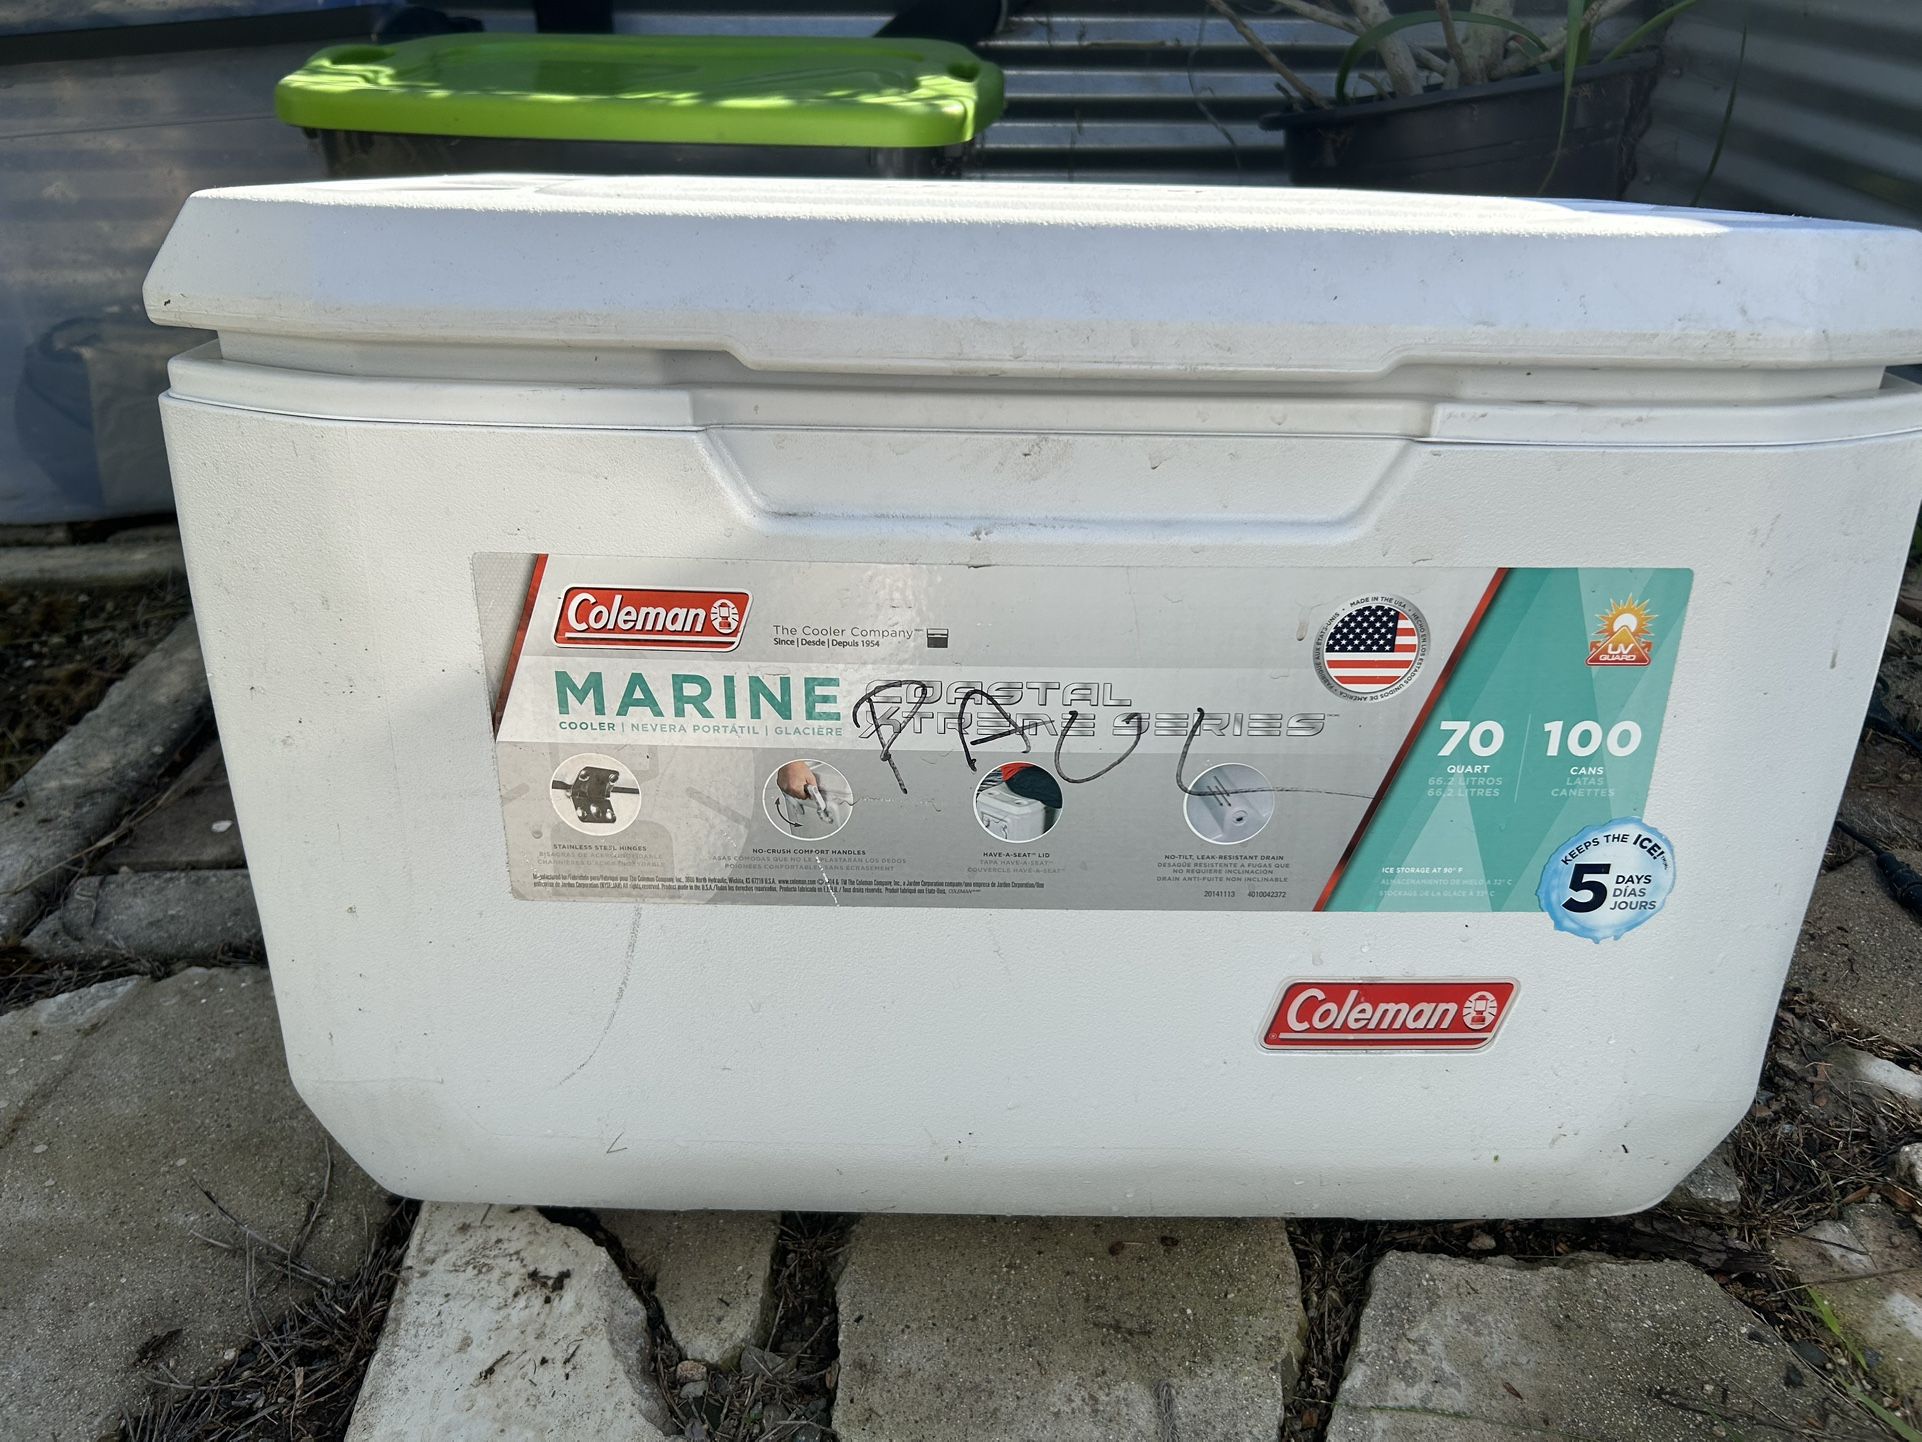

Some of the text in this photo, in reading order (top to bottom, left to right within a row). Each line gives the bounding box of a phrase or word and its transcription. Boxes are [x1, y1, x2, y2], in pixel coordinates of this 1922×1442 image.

[1350, 596, 1370, 608] MADE
[1380, 596, 1393, 604] THE
[1394, 600, 1407, 609] USA
[567, 592, 708, 632] Coleman
[1412, 612, 1426, 632] HECHO
[773, 625, 797, 636] The
[802, 625, 846, 637] Cooler
[774, 638, 880, 648] Since Desde Depuis 1954
[1421, 632, 1427, 644] EN
[1608, 643, 1635, 655] UV
[1404, 657, 1424, 685] ESTADOS
[554, 670, 842, 722] MARINE
[865, 679, 1132, 707] COASTAL
[858, 706, 1326, 738] XTREME SERIES
[558, 721, 843, 737] COOLER NEVERA PORTÁTIL GLACIÈRE
[852, 679, 1262, 796] PAUL
[1437, 720, 1505, 757] 70
[1543, 720, 1642, 757] 100
[1447, 764, 1490, 774] QUART
[1570, 766, 1604, 775] CANS
[1428, 777, 1503, 786] 66.2 LITROS
[1566, 777, 1604, 786] LATAS
[1427, 788, 1501, 797] 66.2 LITRES
[1550, 788, 1616, 797] CANETTES
[1560, 833, 1665, 866] KEEPS THE ICE!
[1615, 875, 1652, 885] DAYS
[1204, 890, 1235, 898] 20141113
[1248, 890, 1287, 898] 4010042372
[1561, 863, 1612, 913] 5
[1612, 885, 1647, 897] DÍAS
[1609, 900, 1656, 911] JOURS
[1286, 988, 1458, 1032] Coleman
